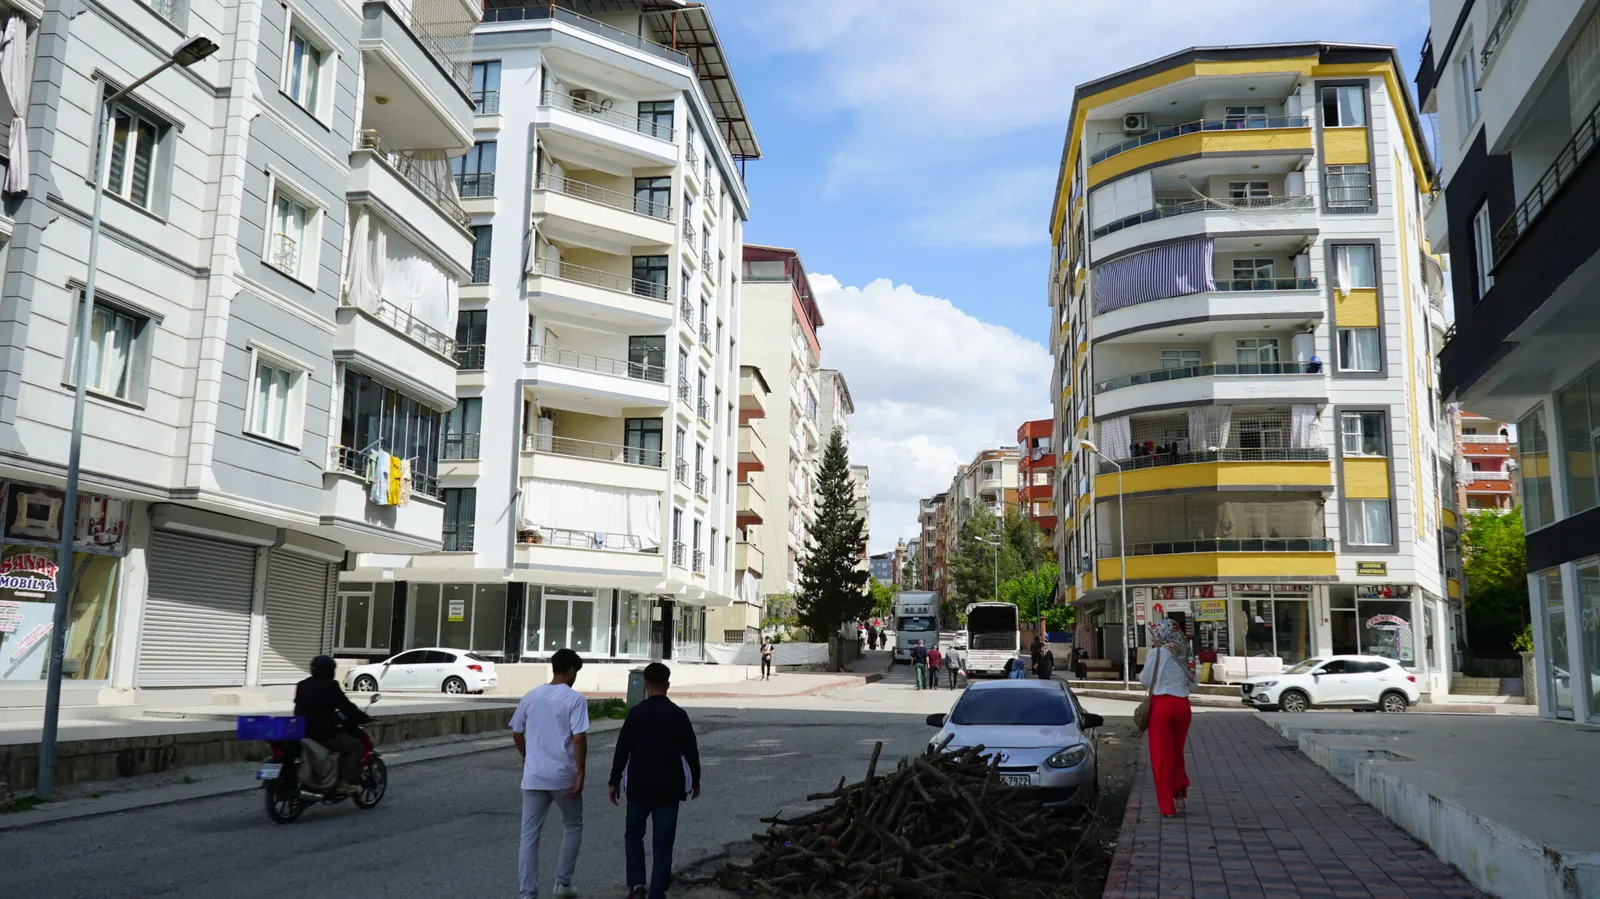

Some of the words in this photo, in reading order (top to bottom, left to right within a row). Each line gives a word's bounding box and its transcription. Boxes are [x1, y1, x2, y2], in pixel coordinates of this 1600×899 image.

[0, 554, 58, 578] SANAT
[0, 576, 56, 591] MOBİLYA
[1008, 776, 1028, 786] 7922
